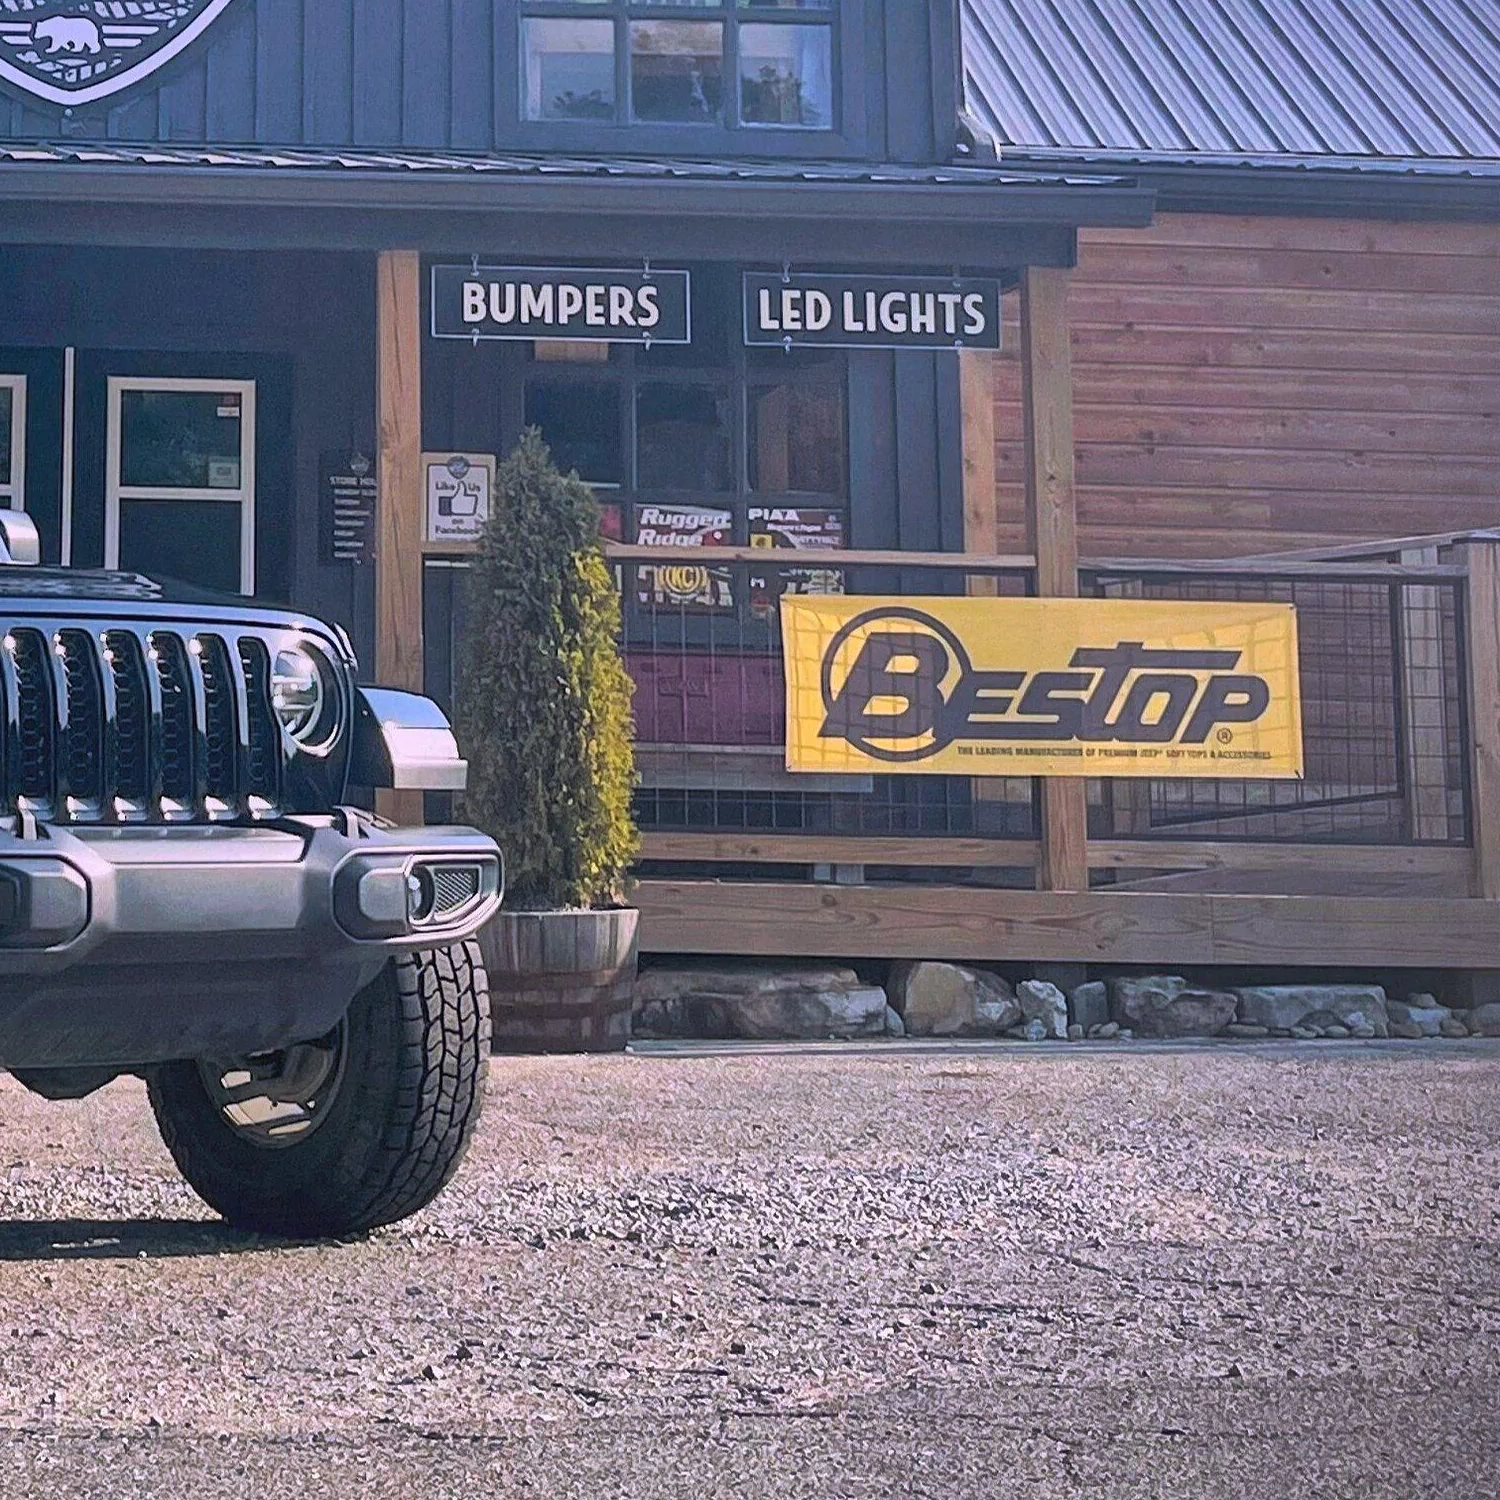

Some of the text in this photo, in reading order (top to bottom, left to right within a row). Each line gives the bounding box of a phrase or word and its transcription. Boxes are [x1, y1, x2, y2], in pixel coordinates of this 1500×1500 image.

[461, 281, 661, 328] BUMPERS
[758, 288, 986, 335] LED LIGHTS
[639, 507, 732, 531] Rugged
[748, 508, 800, 521] PIAA
[637, 529, 704, 547] Ridge
